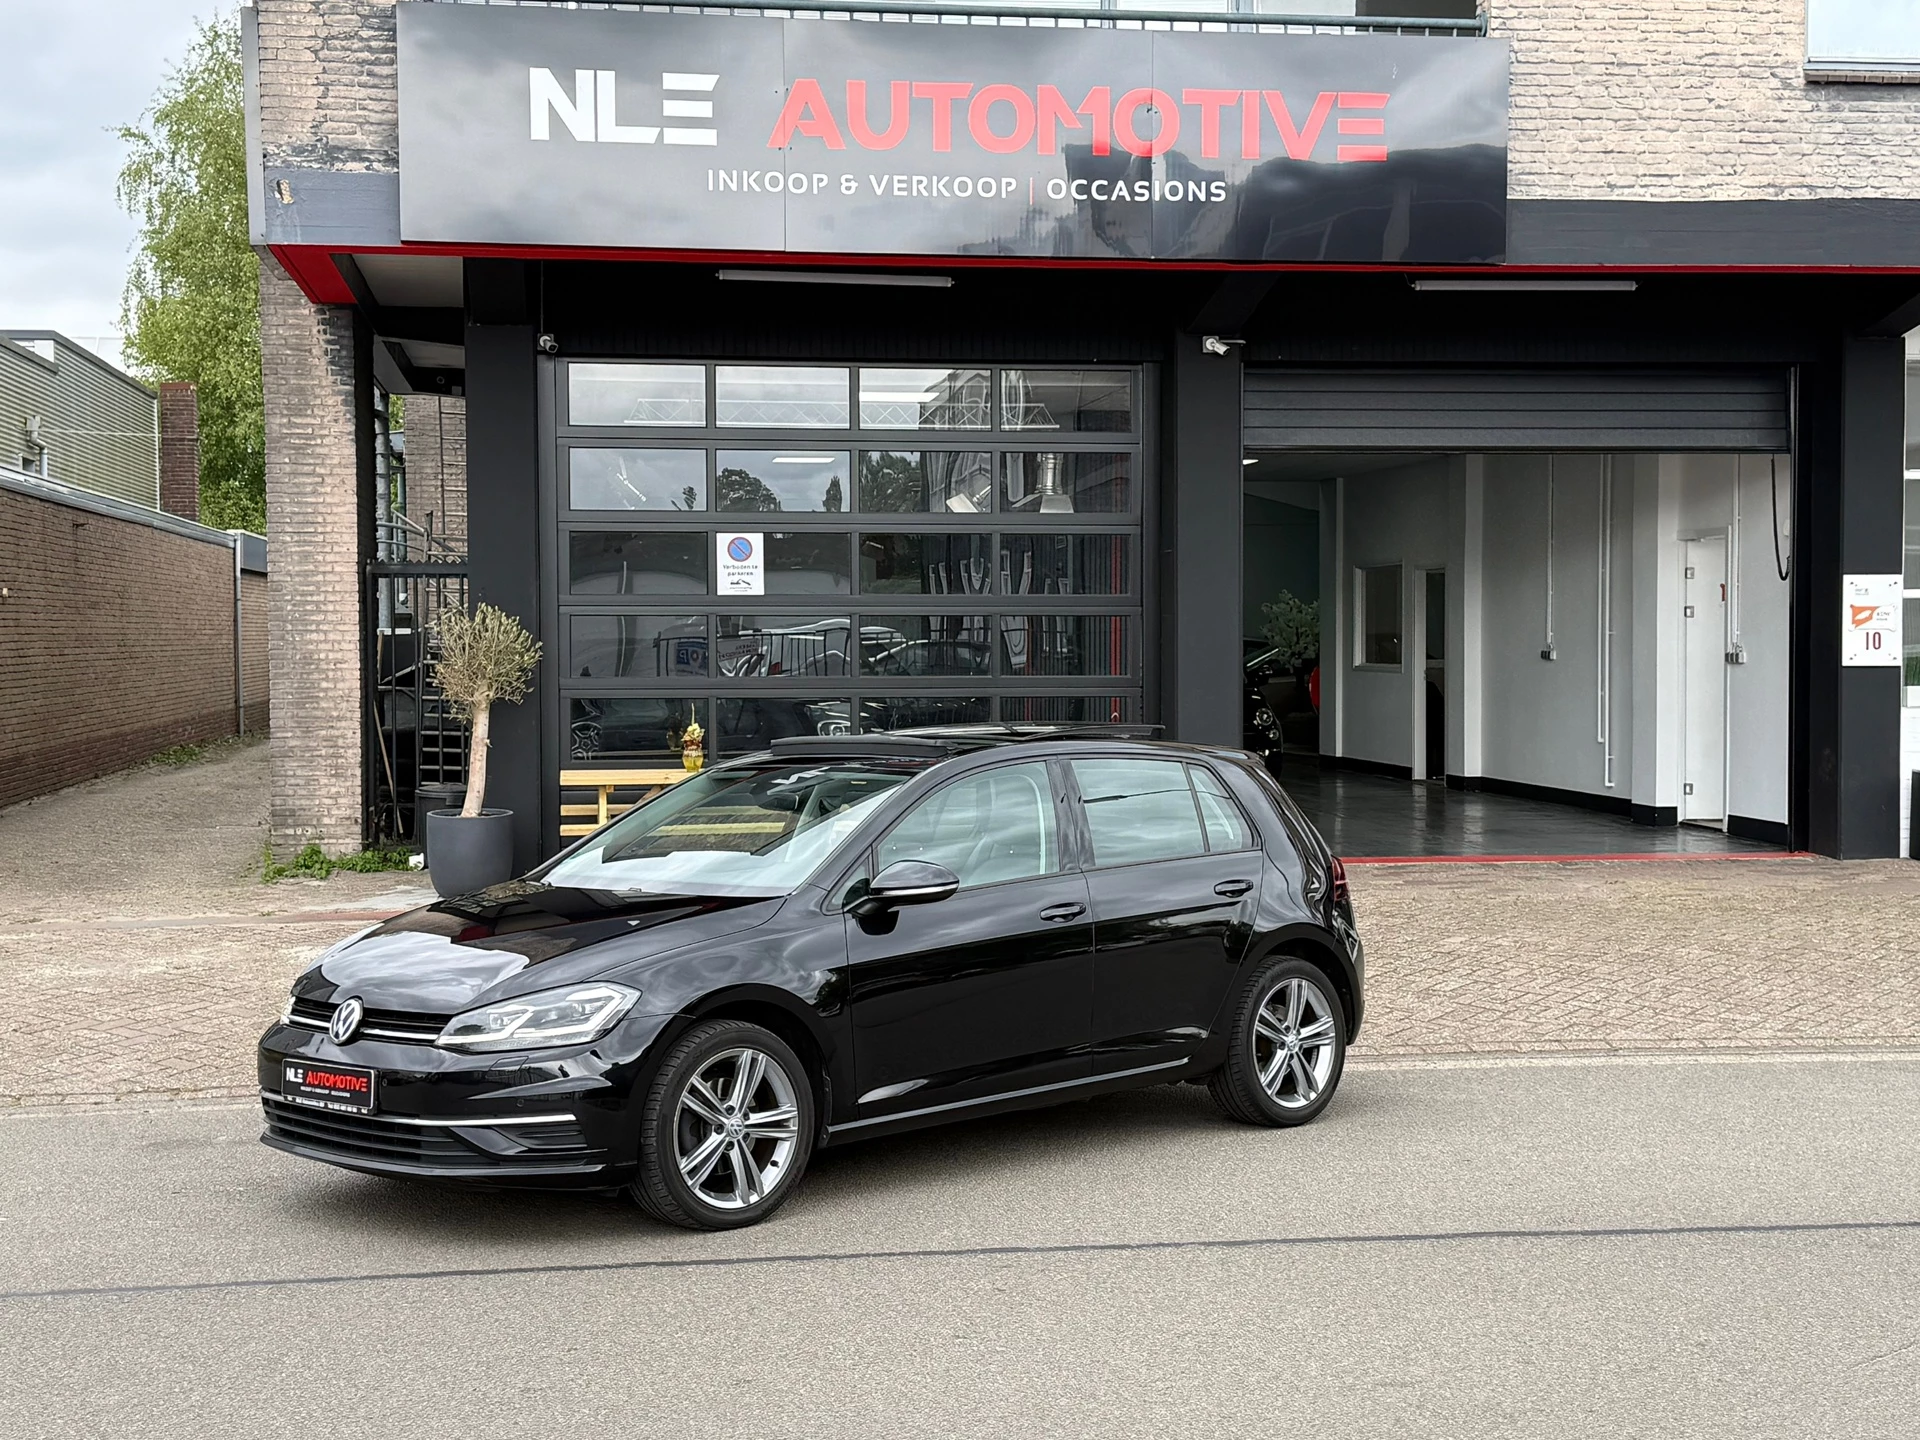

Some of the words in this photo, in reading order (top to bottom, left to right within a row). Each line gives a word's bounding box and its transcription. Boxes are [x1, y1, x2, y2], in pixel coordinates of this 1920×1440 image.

[529, 66, 720, 146] NLE
[766, 78, 1391, 162] AUTOMOTIVE
[707, 169, 829, 195] INKOOP
[840, 173, 859, 195] &
[869, 173, 1018, 199] VERKOOP
[1046, 177, 1227, 202] OCCASIONS
[1866, 631, 1882, 650] 10
[286, 1067, 304, 1083] NLE
[306, 1070, 369, 1092] AUTOMOTIVE
